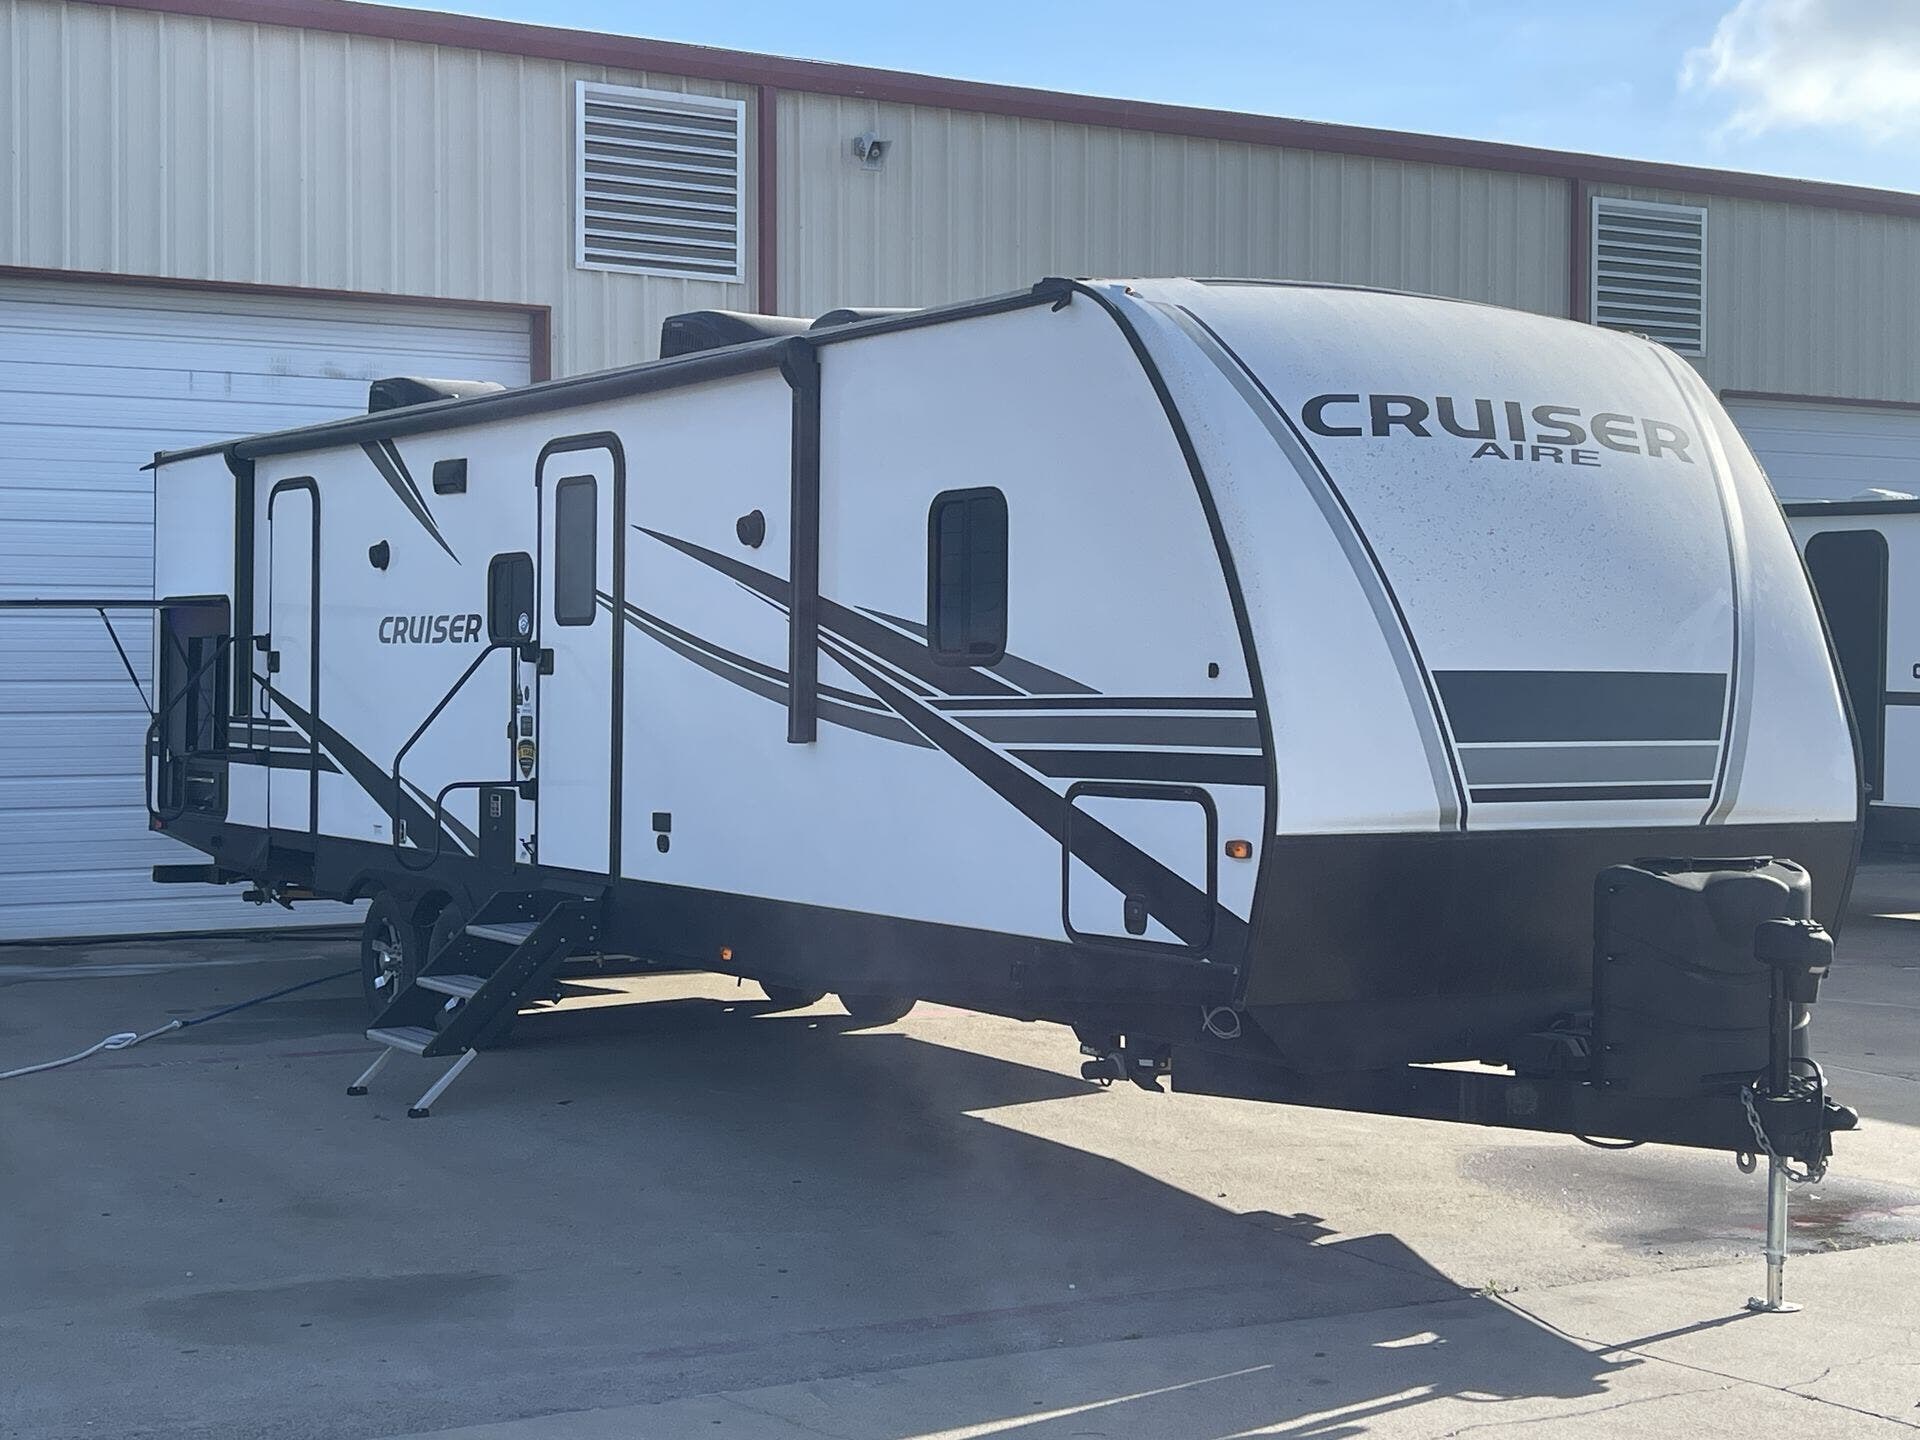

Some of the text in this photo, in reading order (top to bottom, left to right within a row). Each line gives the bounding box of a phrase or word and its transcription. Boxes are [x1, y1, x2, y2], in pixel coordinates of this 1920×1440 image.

[1302, 393, 1695, 463] CRUISER
[1471, 442, 1602, 467] AIRE
[378, 613, 483, 644] CRUISER
